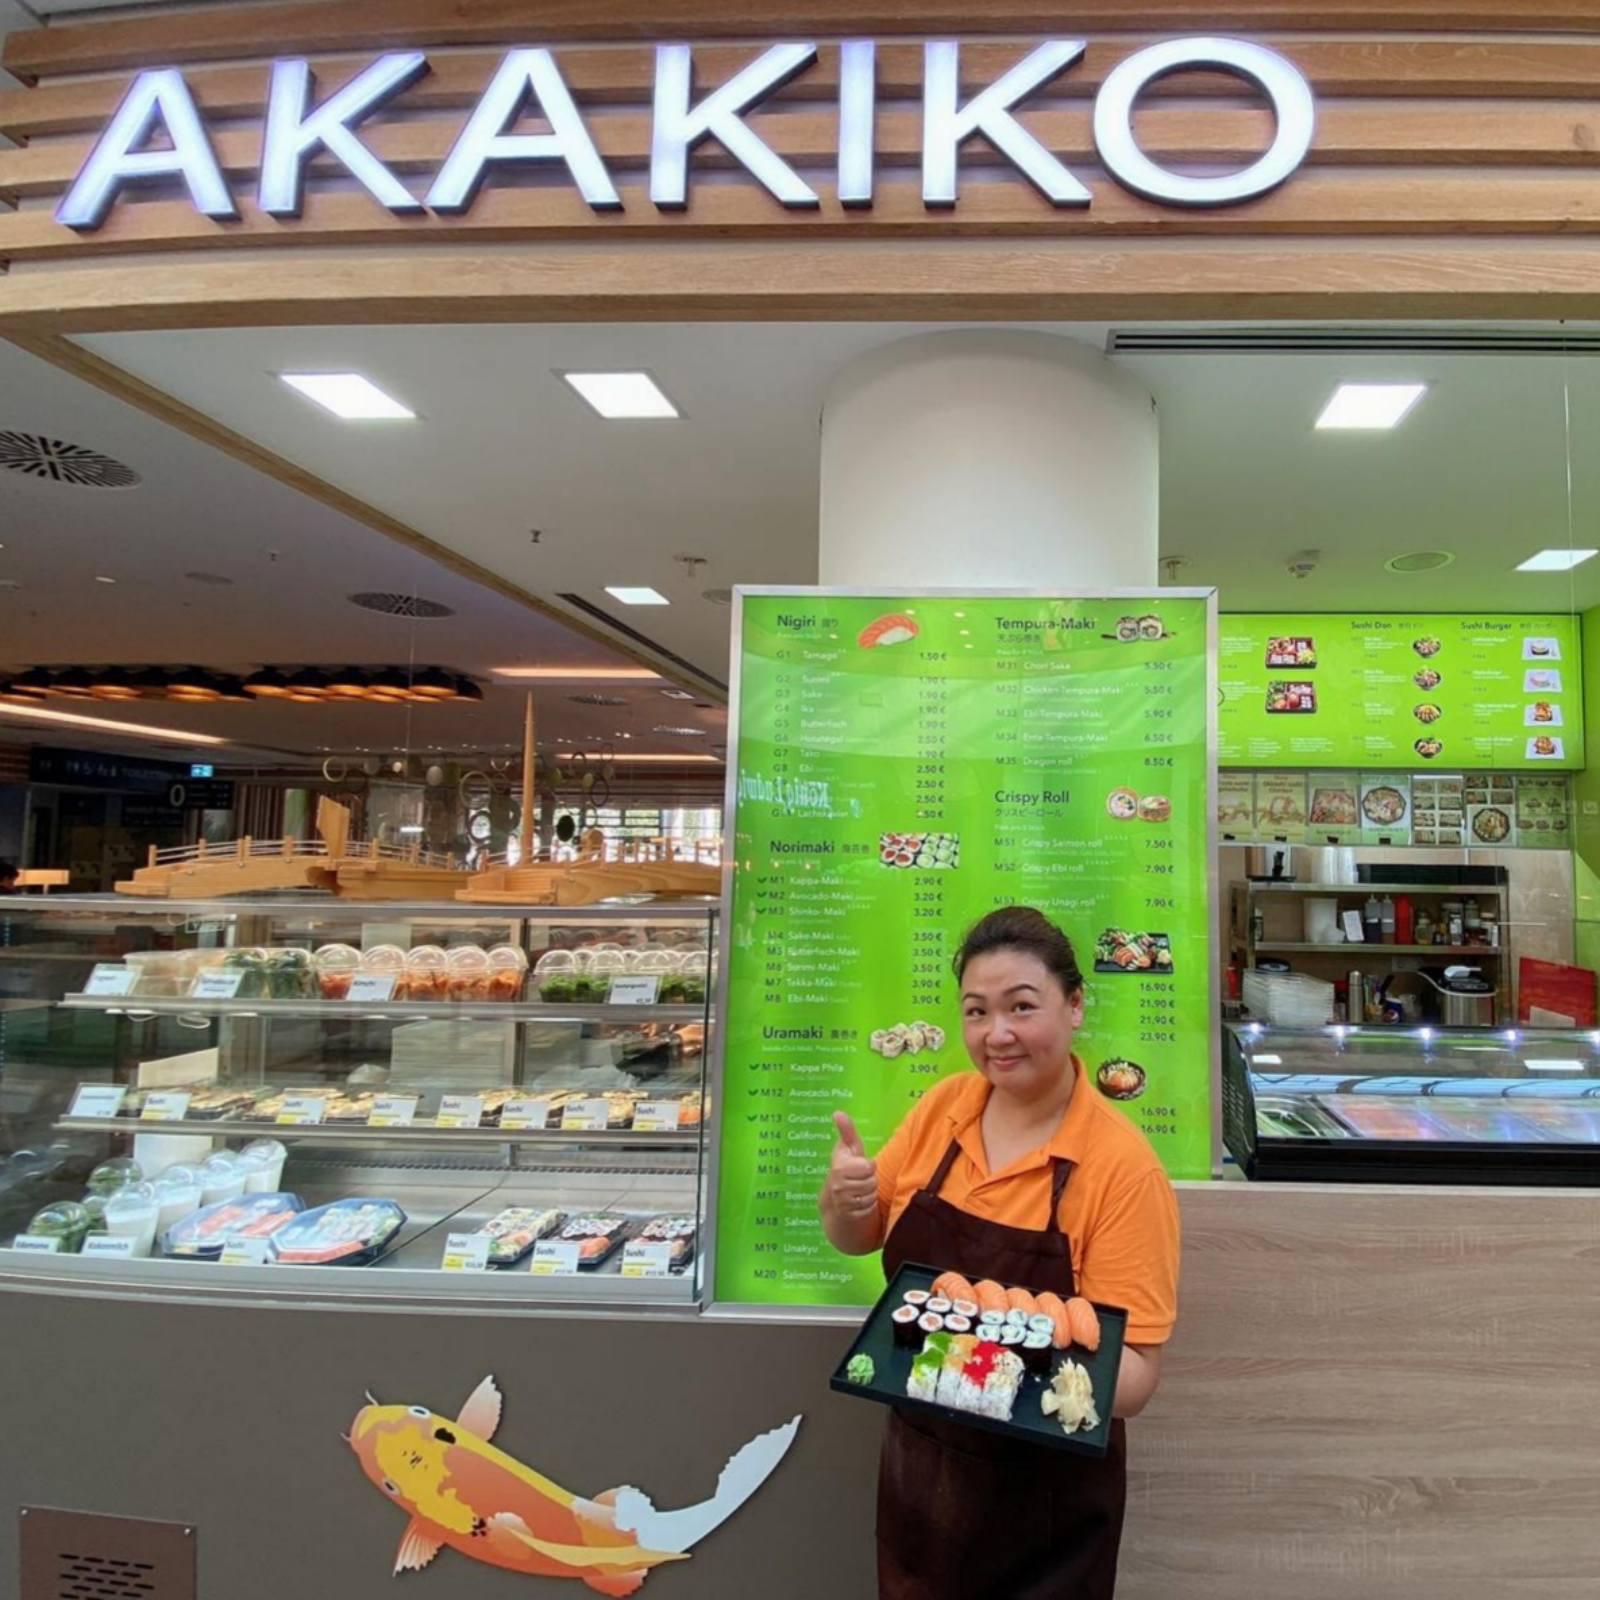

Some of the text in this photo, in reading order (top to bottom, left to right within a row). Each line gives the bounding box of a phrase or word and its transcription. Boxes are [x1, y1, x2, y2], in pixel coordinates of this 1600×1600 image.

[55, 37, 1316, 231] AKAKIKO
[776, 615, 816, 630] Nigiri
[995, 617, 1096, 632] Tempura-Maki
[1460, 621, 1483, 630] Sushi
[1484, 621, 1512, 631] Burger
[916, 765, 937, 774] 2.50
[916, 780, 937, 789] 2.50
[915, 795, 936, 804] 2.50
[995, 789, 1070, 806] Crispy Roll
[769, 840, 835, 854] Norimaki
[1022, 839, 1050, 849] Crispy
[1087, 839, 1103, 848] roll
[1145, 840, 1165, 849] 7.50
[1022, 863, 1050, 874] Crispy
[1051, 863, 1068, 873] Ebi
[1069, 863, 1084, 873] roll
[1145, 865, 1166, 874] 7.90
[790, 876, 844, 887] Kappa-Maki
[914, 878, 935, 886] 2.90
[789, 891, 854, 901] Avocado-Maki
[914, 893, 935, 901] 3.20
[1145, 899, 1166, 908] 7.90
[914, 908, 934, 917] 3.20
[913, 932, 934, 941] 3.50
[913, 948, 934, 957] 3.50
[912, 964, 934, 973] 3.50
[912, 980, 933, 988] 3.90
[1140, 983, 1166, 992] 16.90
[787, 993, 828, 1003] Ebi-Maki
[912, 995, 933, 1004] 3.90
[1140, 999, 1166, 1008] 21.90
[1140, 1015, 1166, 1025] 21.90
[762, 1026, 823, 1039] Uramaki
[1140, 1032, 1166, 1042] 23.90
[790, 1063, 820, 1073] Kappa
[822, 1063, 845, 1072] Phila
[910, 1065, 931, 1073] 3.90
[760, 1088, 783, 1097] M12
[789, 1088, 830, 1098] Avocado
[831, 1088, 854, 1098] Phila
[1141, 1107, 1167, 1117] 16.90
[760, 1114, 782, 1123] M13
[760, 1130, 831, 1140] M14 California
[758, 1148, 817, 1157] M15 Alaska
[758, 1165, 780, 1173] M16
[786, 1164, 802, 1174] Ebi
[756, 1191, 779, 1199] M17
[755, 1216, 820, 1226] M18 Salmon
[448, 1239, 468, 1248] Sushi
[754, 1242, 818, 1255] M19 Unakyu
[535, 1247, 556, 1256] Sushi
[625, 1249, 645, 1257] Sushi
[754, 1269, 853, 1284] M20 Salmon Mango
